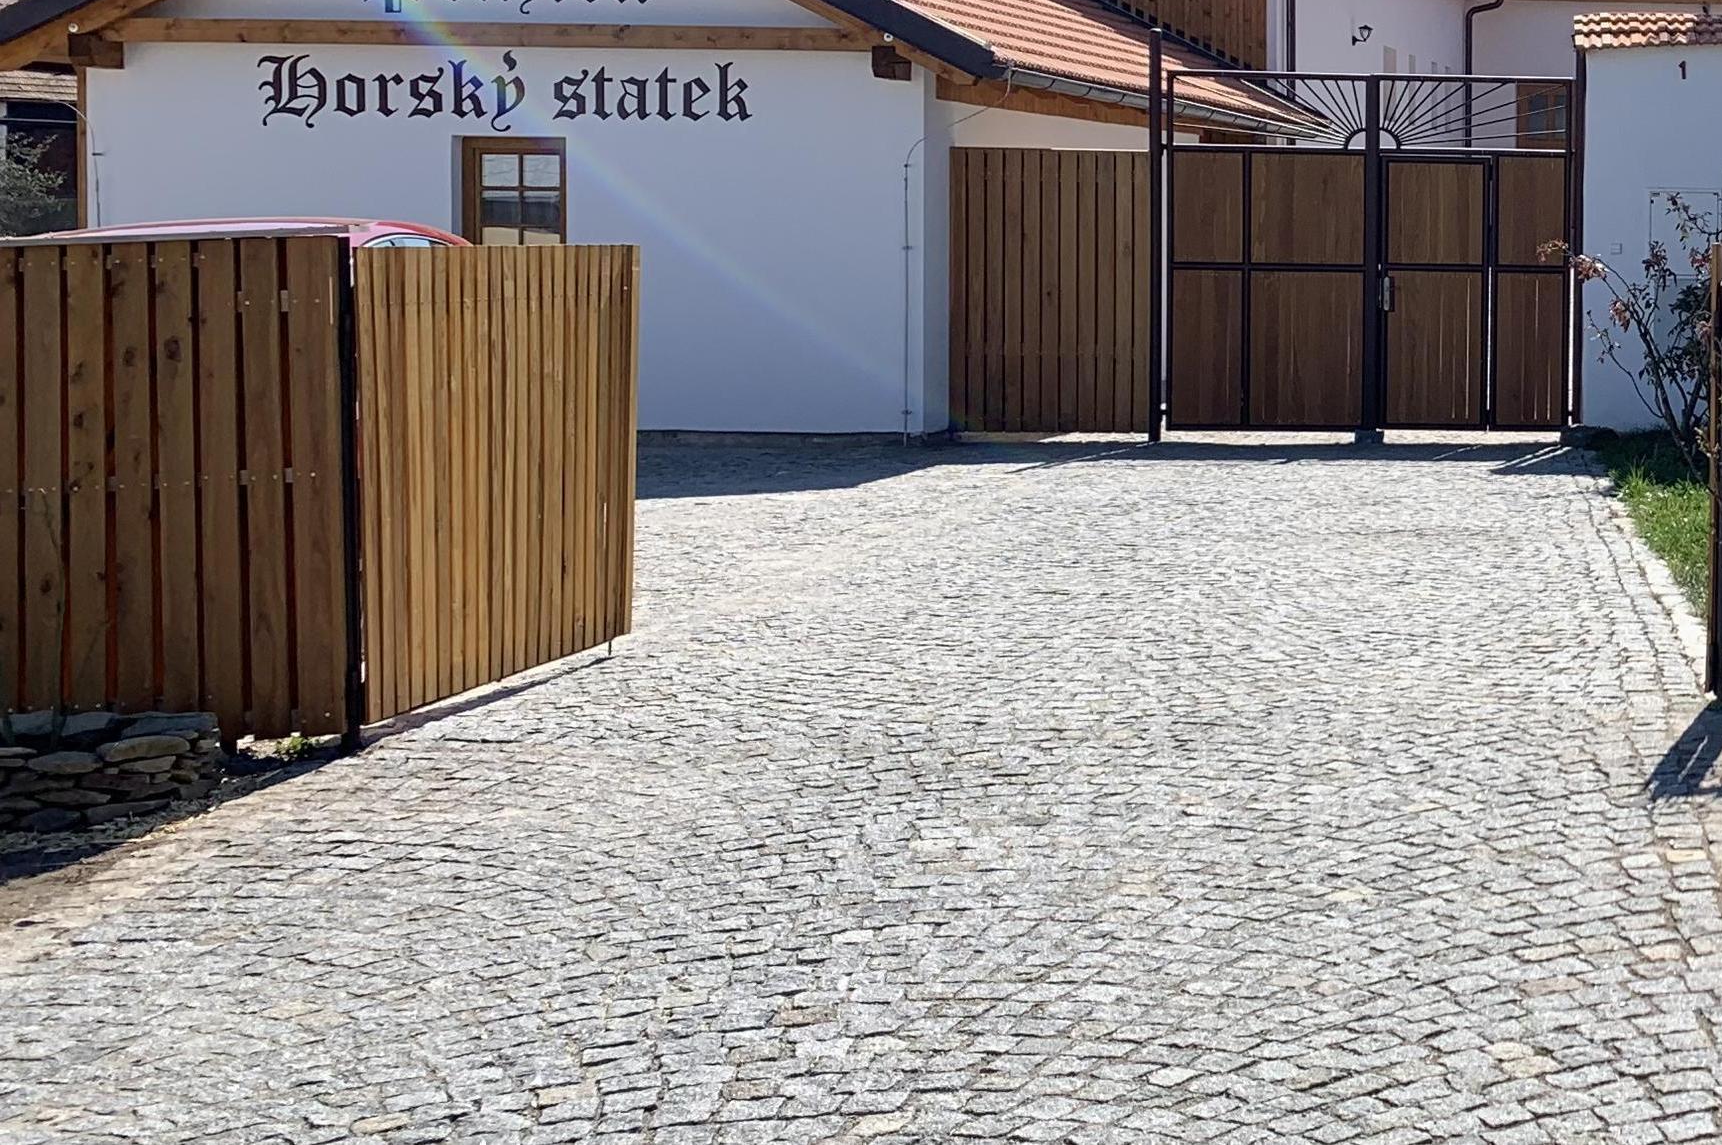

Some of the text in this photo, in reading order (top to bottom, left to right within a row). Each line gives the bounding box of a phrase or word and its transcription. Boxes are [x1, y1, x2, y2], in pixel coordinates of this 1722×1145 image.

[257, 50, 753, 132] Horský statek
[1678, 60, 1687, 80] 1
